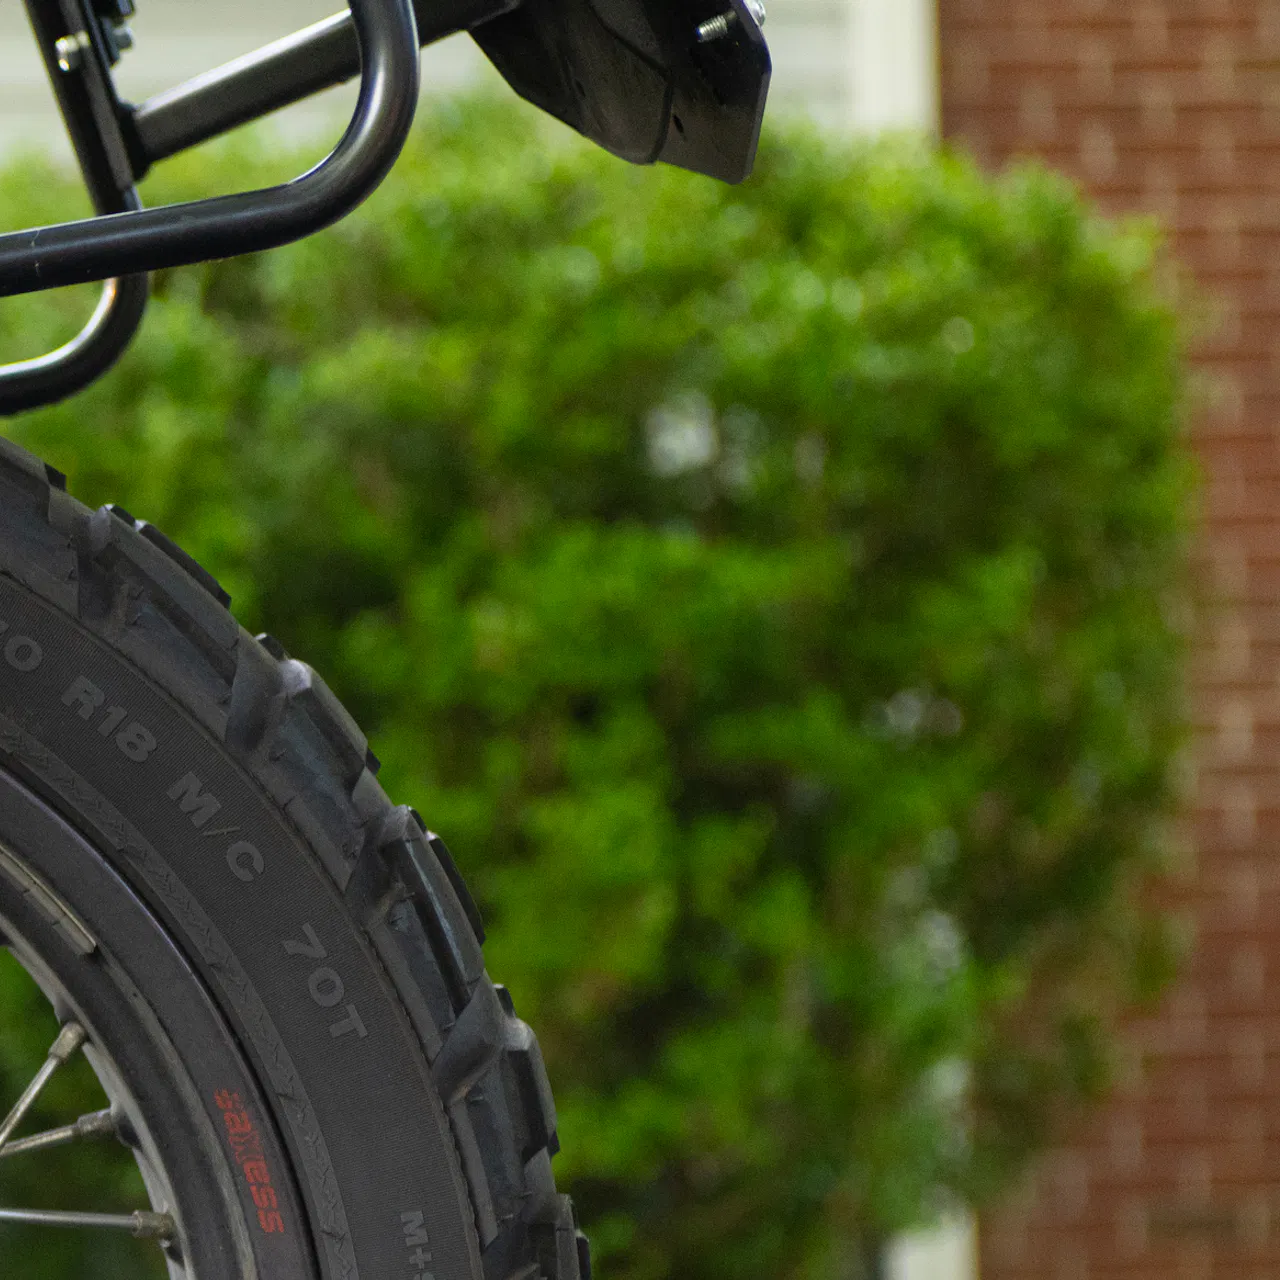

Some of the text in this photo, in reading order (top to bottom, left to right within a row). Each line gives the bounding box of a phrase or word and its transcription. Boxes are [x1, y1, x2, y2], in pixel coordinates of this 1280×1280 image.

[59, 674, 157, 763] R18
[165, 771, 265, 883] M/C
[283, 922, 369, 1041] 70T
